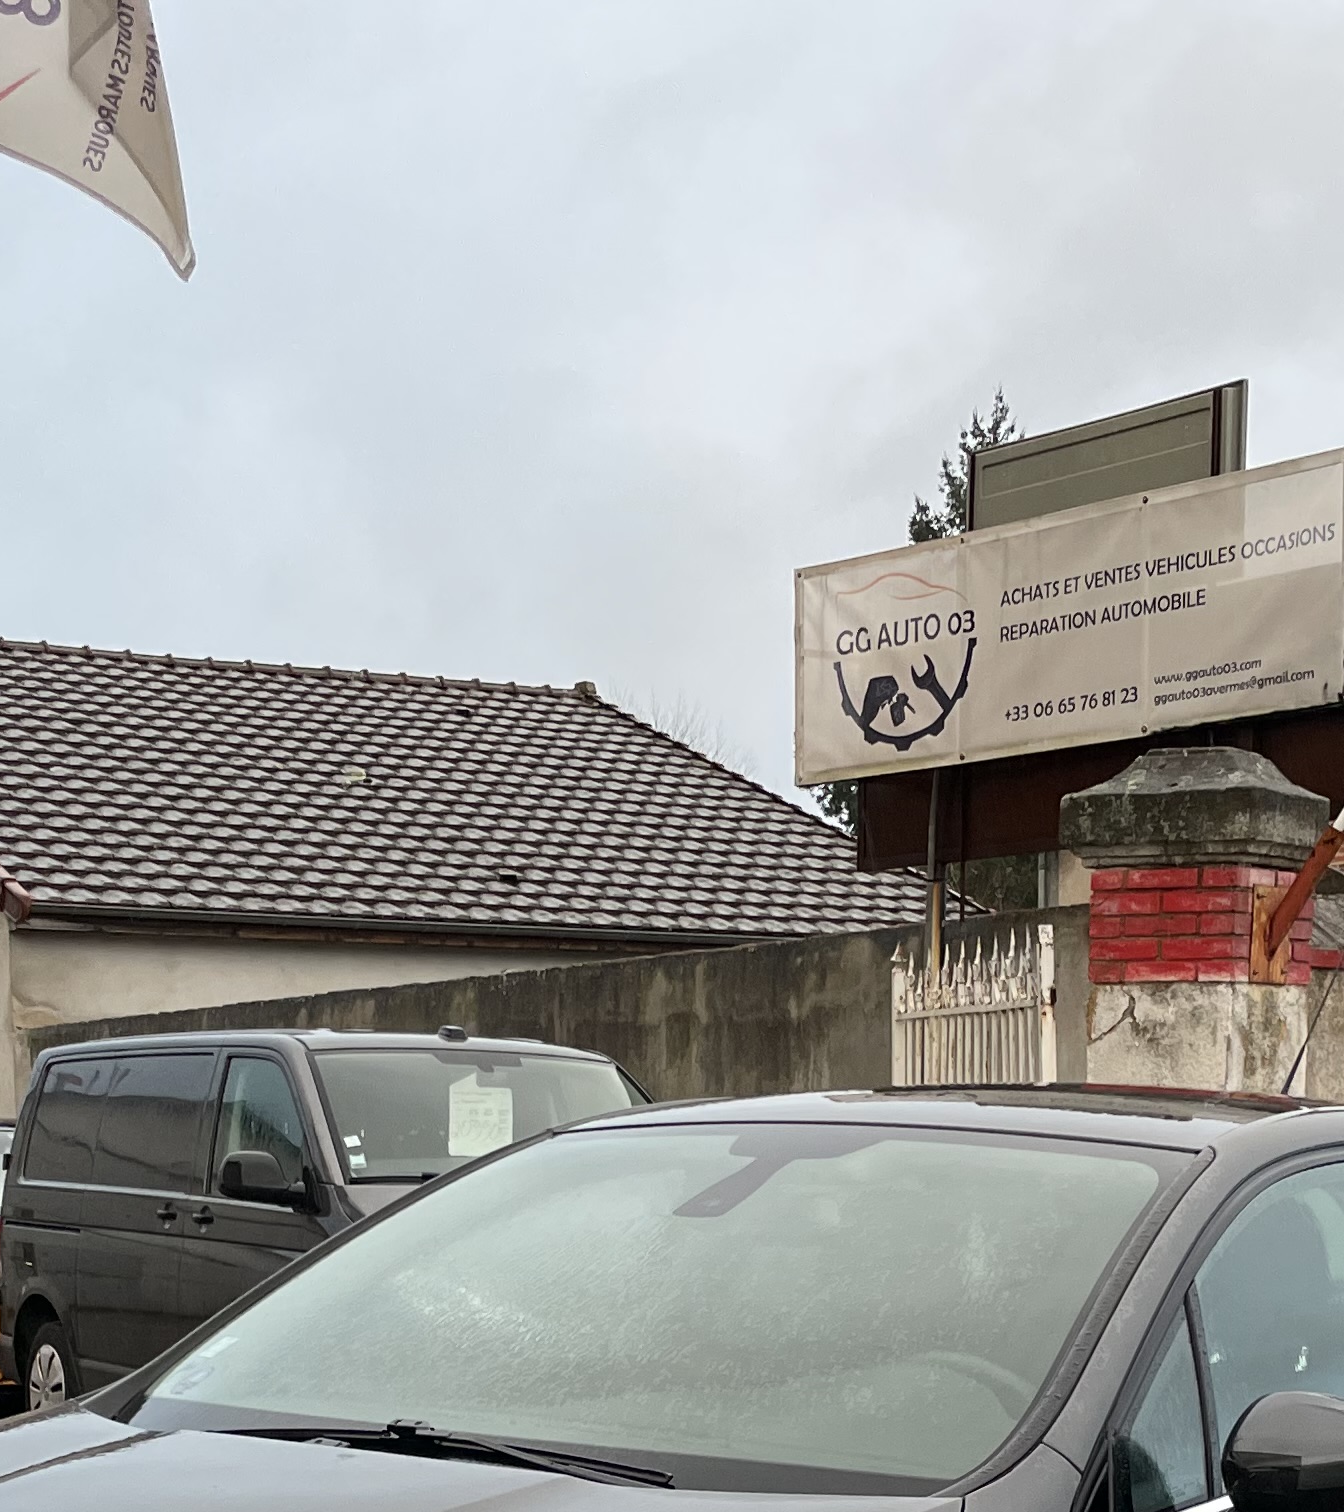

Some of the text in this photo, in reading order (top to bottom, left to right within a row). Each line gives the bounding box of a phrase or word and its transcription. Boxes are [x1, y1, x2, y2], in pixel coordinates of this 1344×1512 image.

[1000, 522, 1336, 607] ACHATS ET VENTES VEHICULES OCCASIONS
[836, 609, 976, 655] GG AUTO 03
[1000, 588, 1206, 642] REPARATION AUTOMOBILE
[1153, 658, 1262, 685] www.ggauto03.com
[1153, 669, 1315, 706] ggauto03avermes@gmail.com
[1004, 686, 1138, 722] +33 06 65 76 81 23
